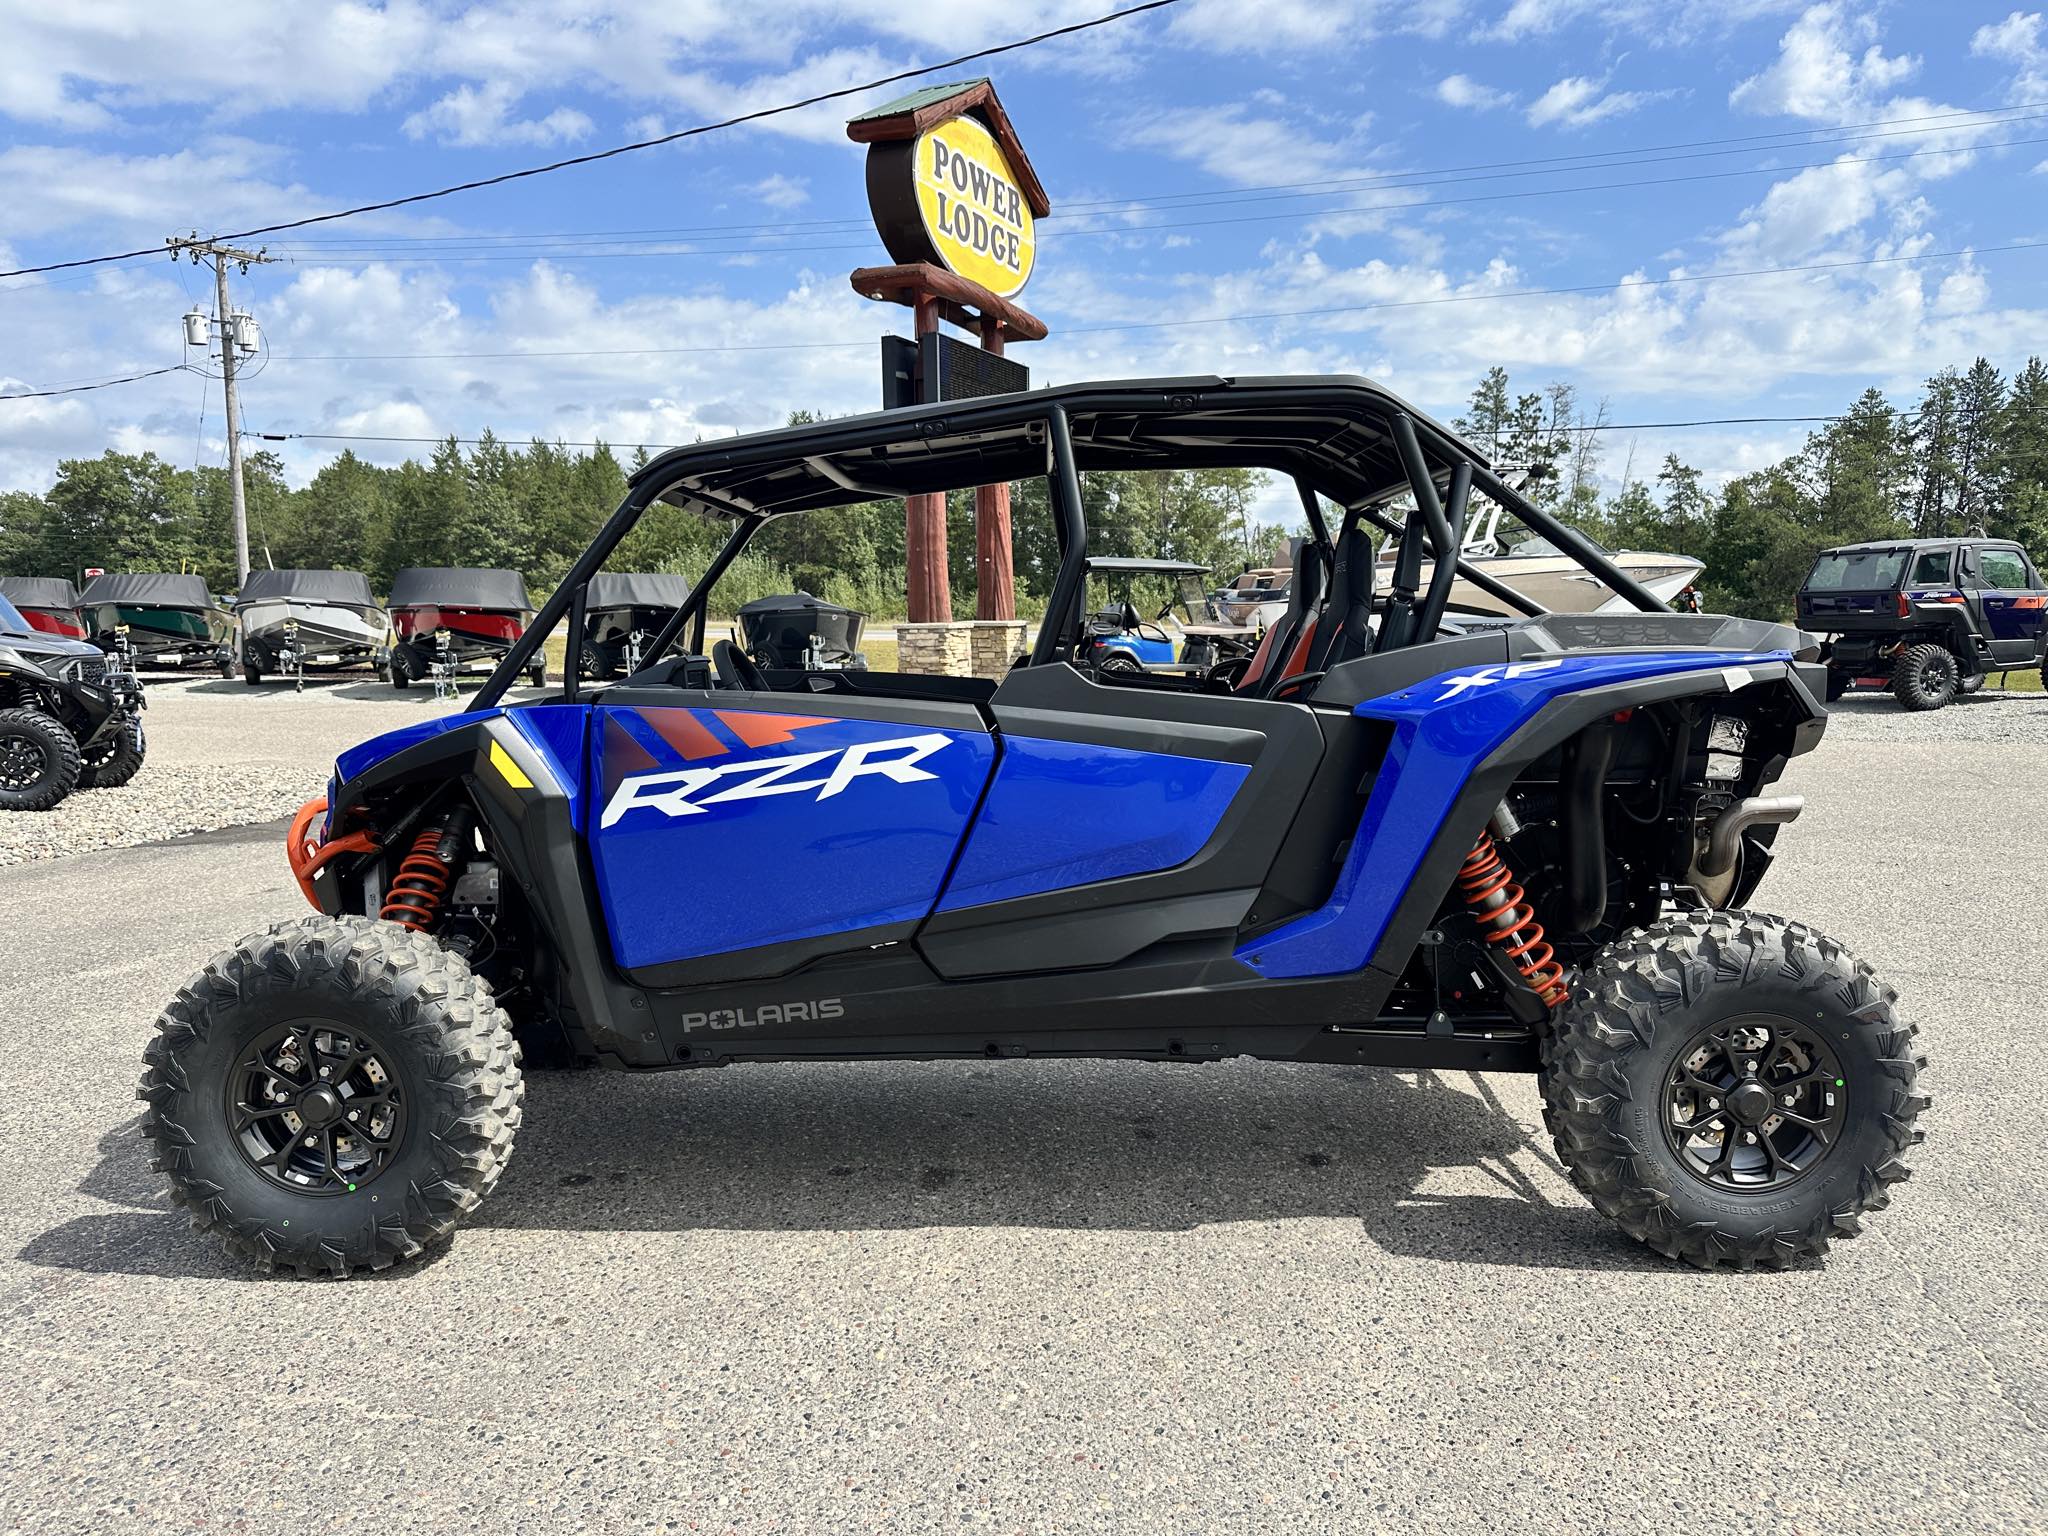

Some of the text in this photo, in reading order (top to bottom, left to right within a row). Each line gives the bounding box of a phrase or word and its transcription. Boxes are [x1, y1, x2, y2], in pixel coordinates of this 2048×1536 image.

[933, 139, 1022, 228] POWER
[937, 192, 1020, 271] LODGE
[1434, 659, 1563, 702] XP
[601, 733, 953, 830] RZR
[682, 998, 845, 1033] POLARIS
